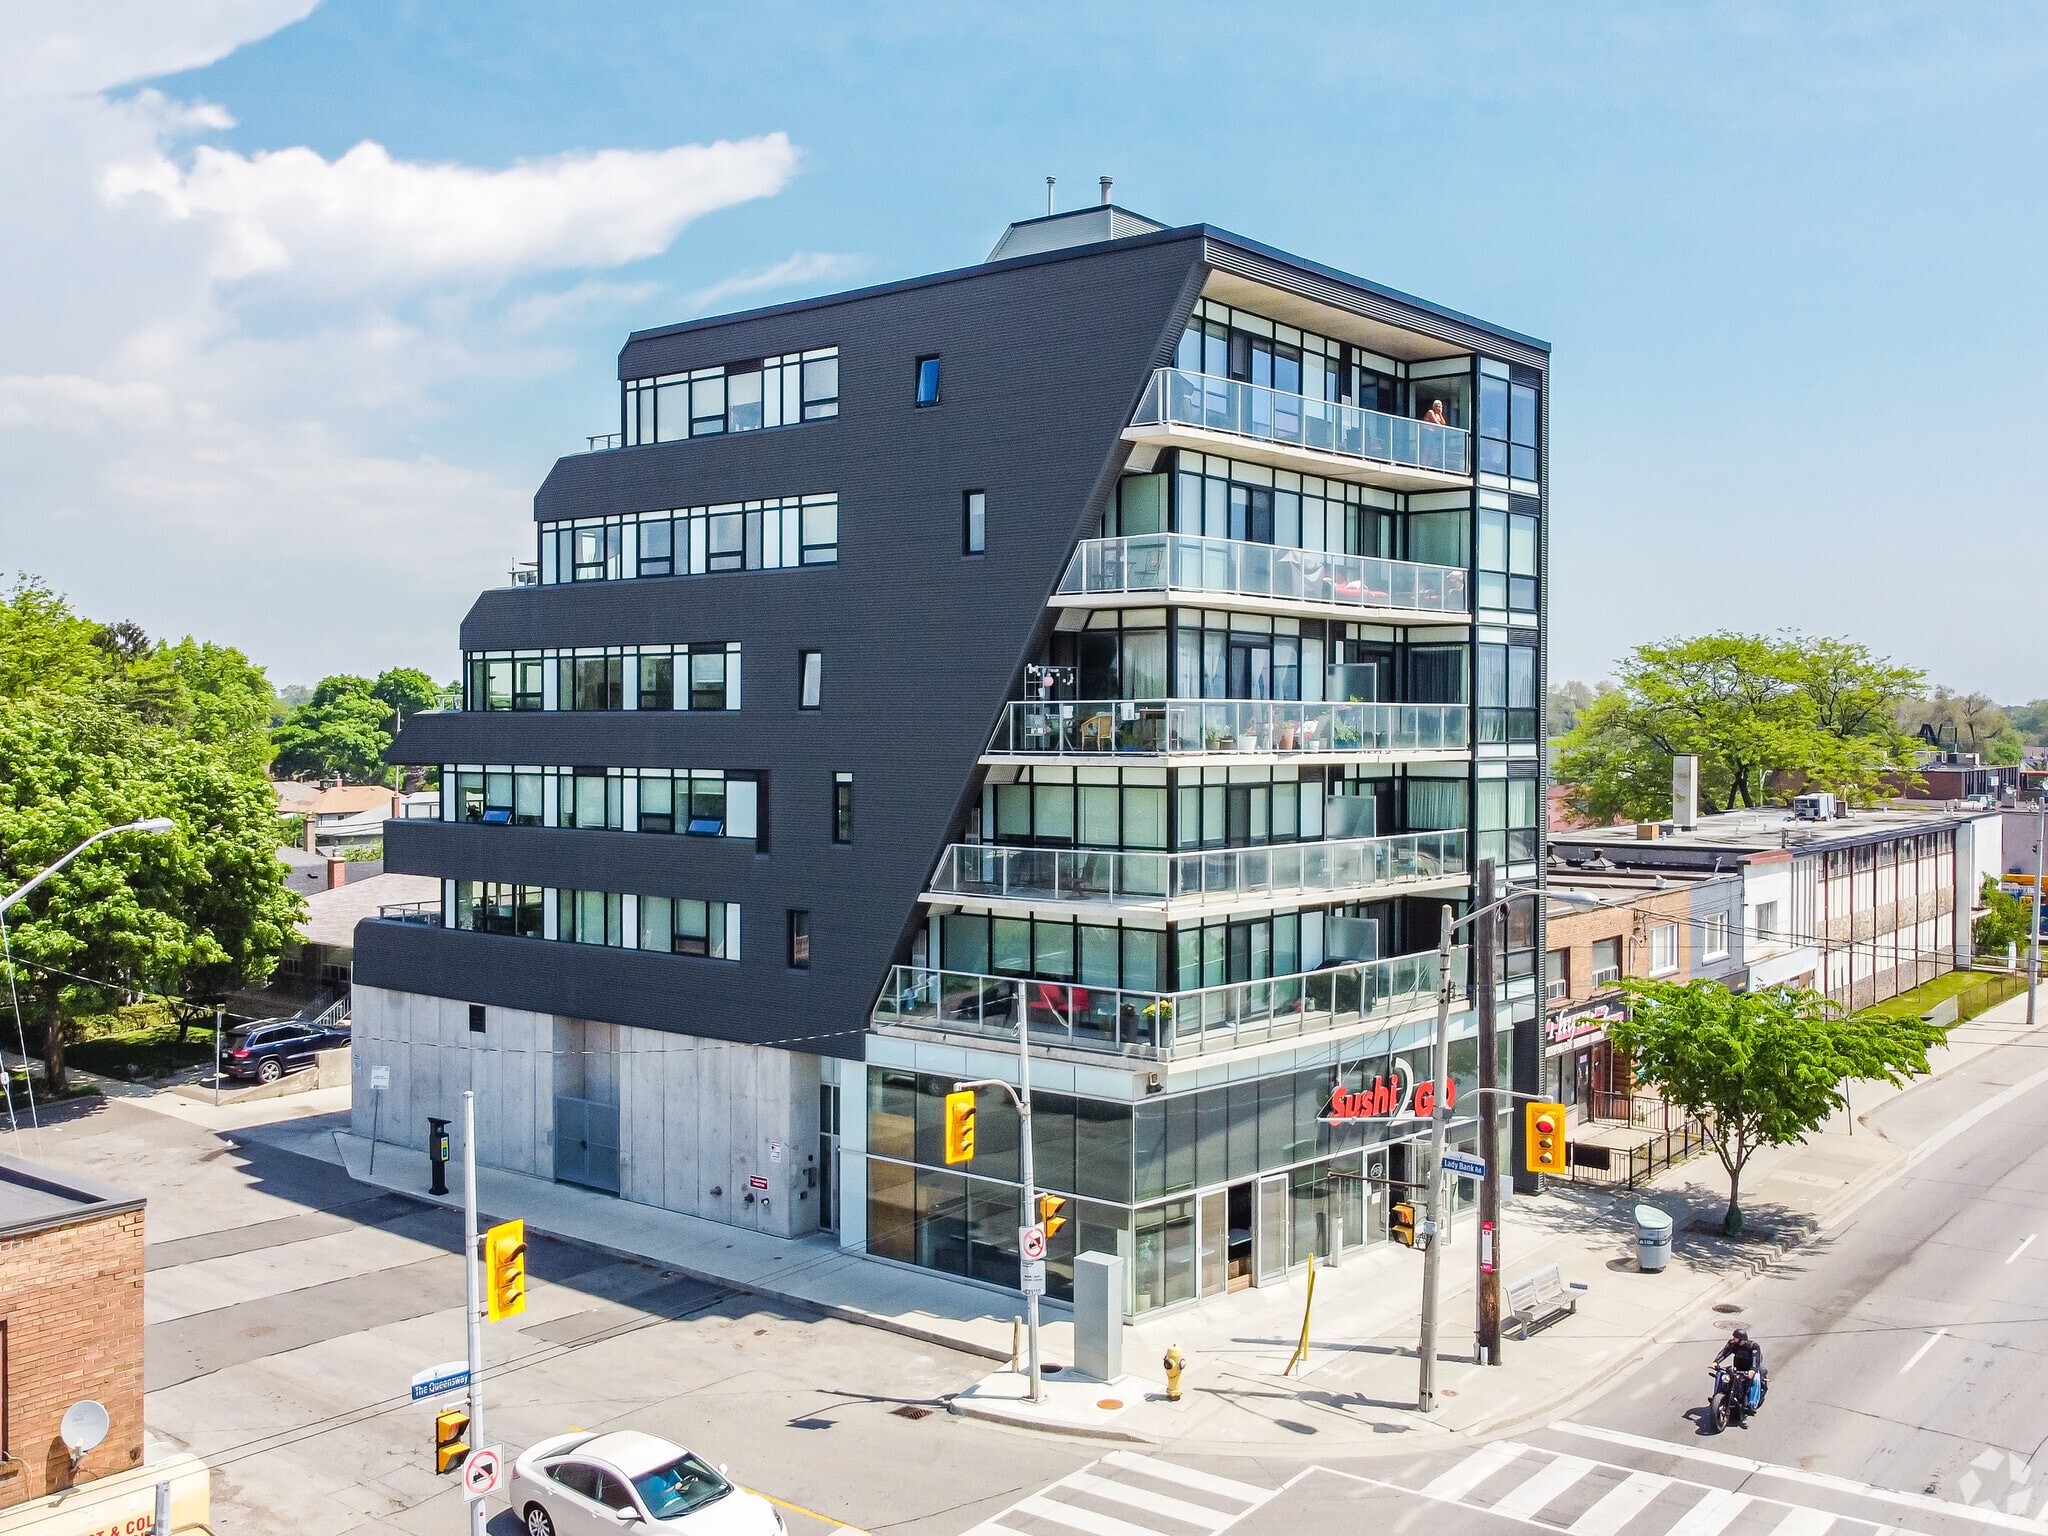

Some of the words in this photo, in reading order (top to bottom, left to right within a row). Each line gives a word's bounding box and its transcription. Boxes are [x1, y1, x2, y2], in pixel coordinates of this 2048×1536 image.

[1329, 1074, 1399, 1127] Sushi
[1387, 1057, 1415, 1127] 2
[1444, 1160, 1458, 1169] Lady
[1459, 1162, 1475, 1172] Bank
[415, 1386, 428, 1397] The
[429, 1374, 469, 1392] Queensway
[126, 1515, 154, 1534] COL
